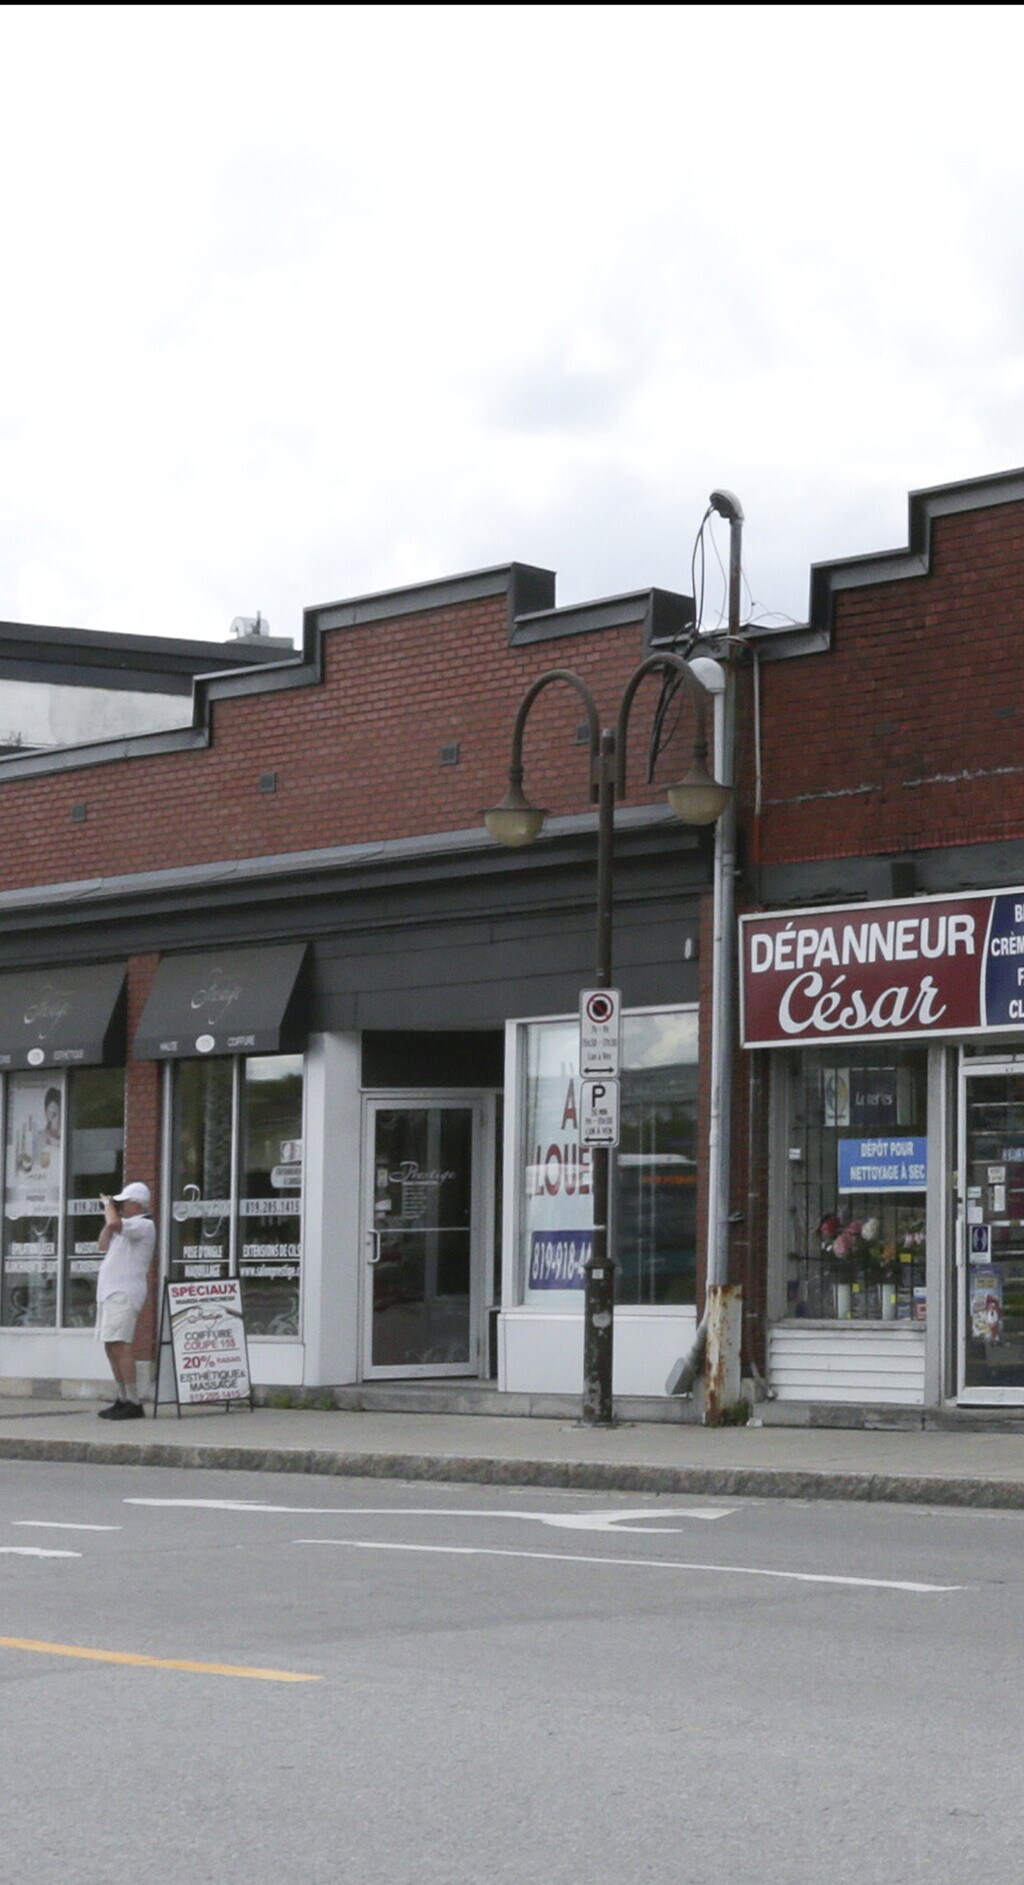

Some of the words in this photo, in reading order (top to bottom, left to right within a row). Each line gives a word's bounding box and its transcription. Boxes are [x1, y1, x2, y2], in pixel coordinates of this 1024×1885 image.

[751, 914, 975, 973] DÉPANNEUR
[778, 971, 947, 1034] César
[592, 1085, 606, 1108] P
[861, 1140, 889, 1157] DÉPÔT
[890, 1141, 914, 1156] POUR
[388, 1161, 456, 1186] Prestige
[534, 1144, 594, 1196] LOUE
[850, 1165, 899, 1180] NETTOYAGE
[900, 1161, 908, 1180] À
[908, 1164, 925, 1180] SEC
[279, 1243, 287, 1257] DE
[171, 1283, 237, 1297] SPÉCIAUX
[184, 1329, 232, 1340] COIFFURE
[183, 1340, 218, 1351] COUPE
[183, 1355, 215, 1369] 20%
[189, 1379, 239, 1391] MASSAGE
